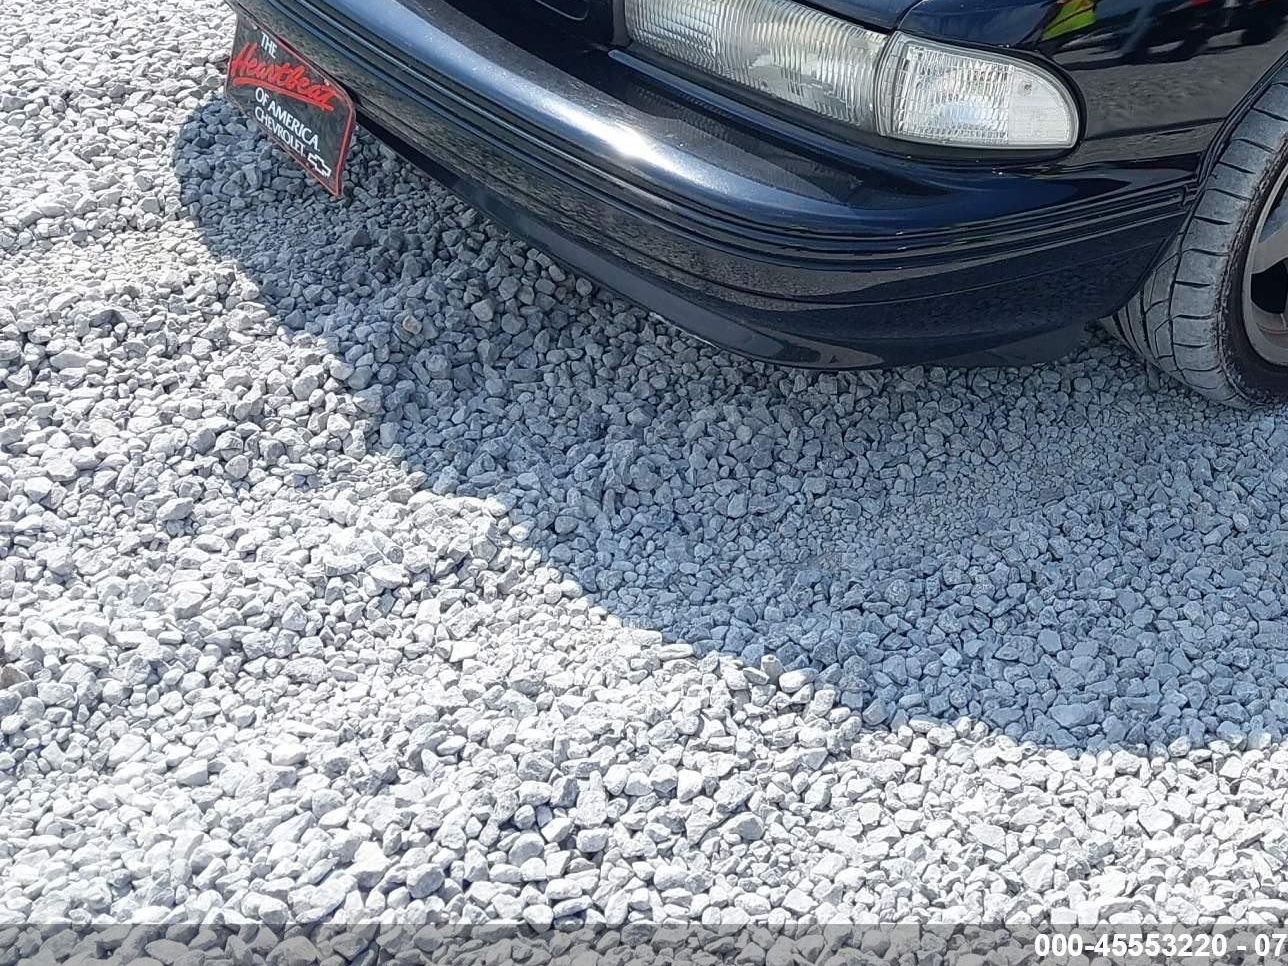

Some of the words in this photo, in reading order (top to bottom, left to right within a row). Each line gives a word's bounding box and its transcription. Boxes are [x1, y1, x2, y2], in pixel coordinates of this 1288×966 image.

[260, 31, 278, 59] THE
[230, 41, 338, 108] Heartbeat
[255, 86, 270, 107] OF
